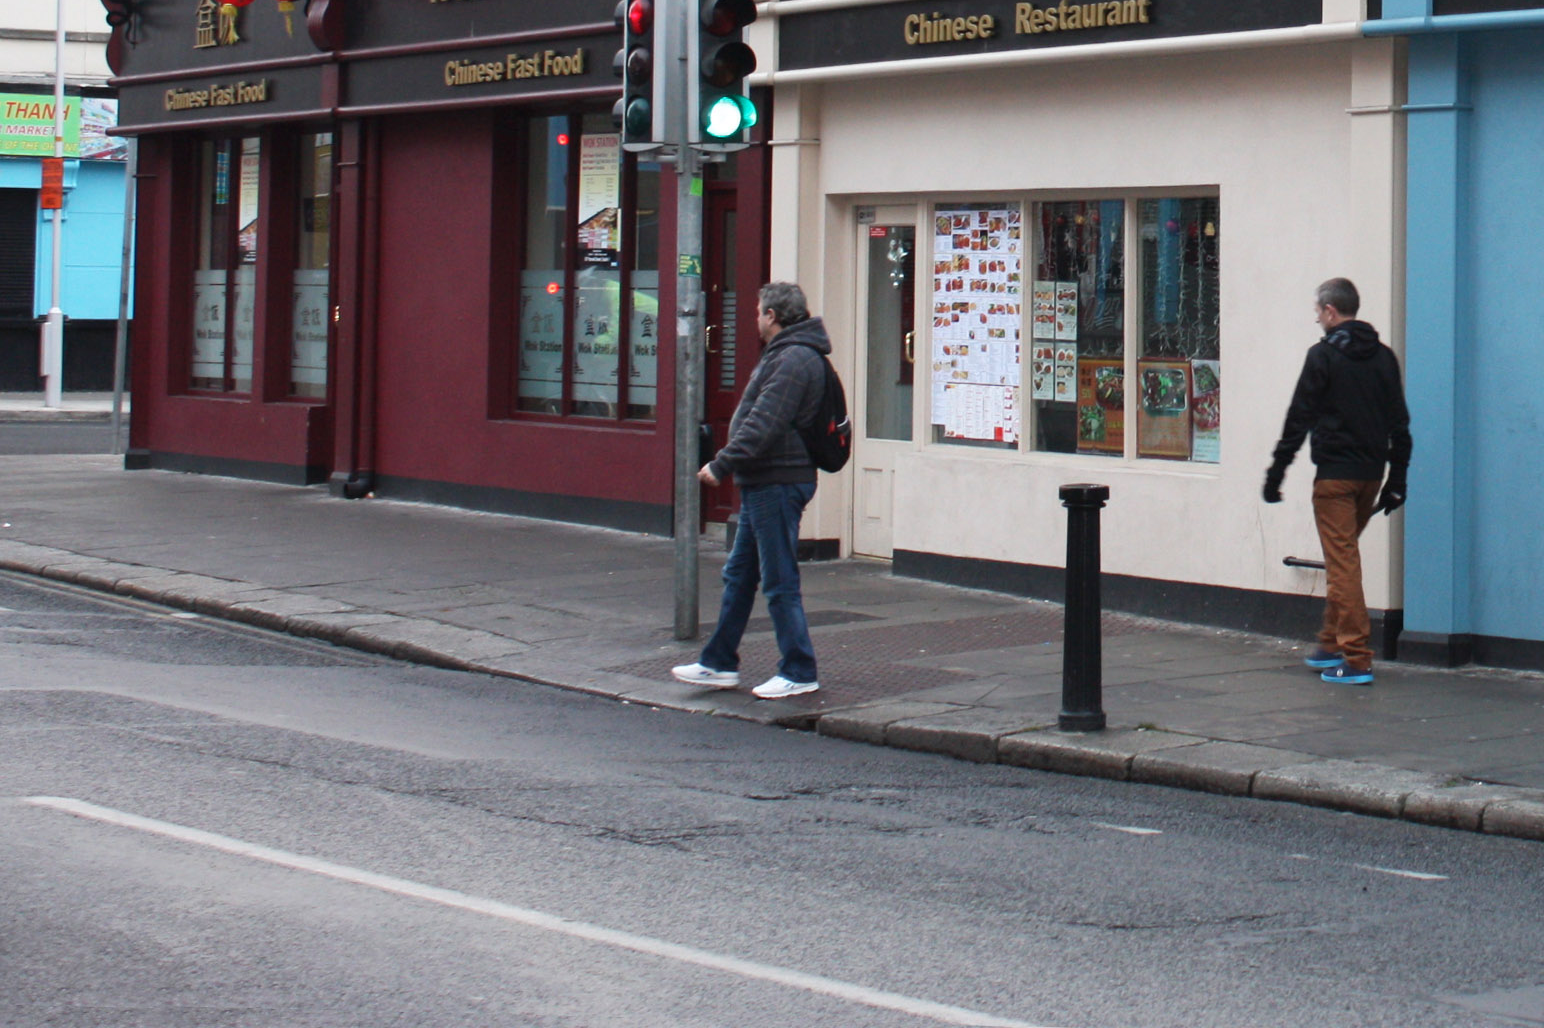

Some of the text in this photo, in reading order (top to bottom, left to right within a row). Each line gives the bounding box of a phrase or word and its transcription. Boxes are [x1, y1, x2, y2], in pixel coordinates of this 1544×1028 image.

[904, 8, 994, 46] Chinese
[445, 48, 584, 86] Chinese Fast Food
[164, 78, 267, 111] Chinese Fast Food
